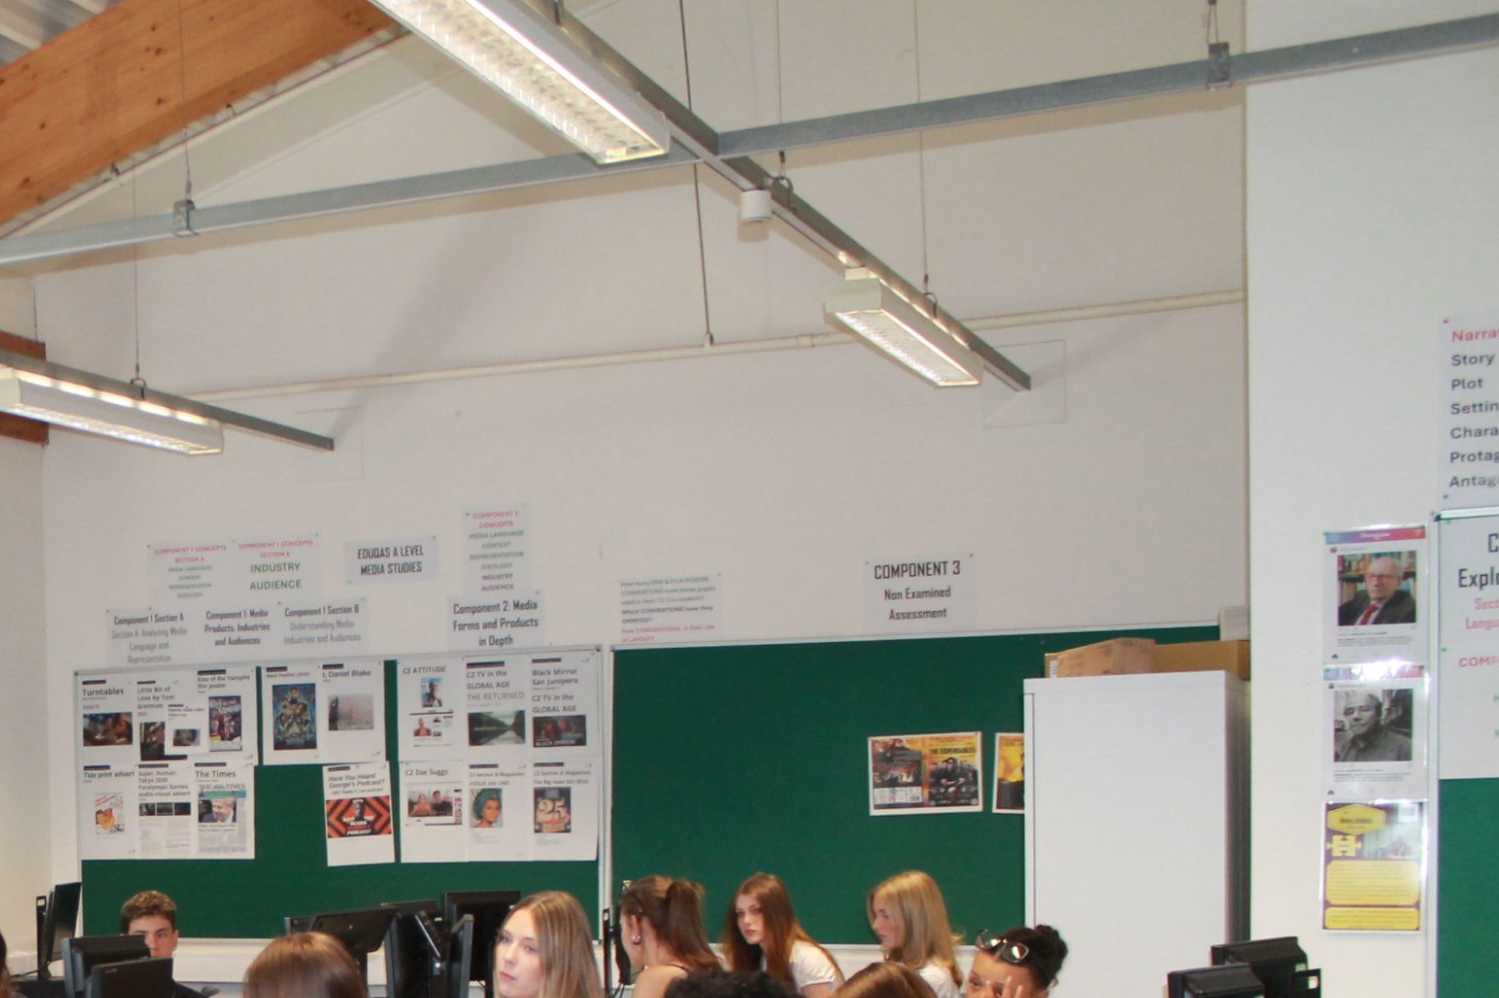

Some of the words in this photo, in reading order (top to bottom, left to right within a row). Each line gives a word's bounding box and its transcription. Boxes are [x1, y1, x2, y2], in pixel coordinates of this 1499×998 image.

[1451, 354, 1495, 369] Story
[1451, 379, 1484, 391] Plot
[1451, 402, 1499, 415] Settin
[473, 511, 514, 519] COMPONENT
[478, 521, 514, 529] CONCEPTS
[468, 532, 488, 540] MEDIA
[490, 530, 524, 538] LANGUAGE
[154, 546, 189, 555] COMPONENT
[239, 541, 275, 550] COMPONENT
[357, 547, 391, 559] EDUQAS
[393, 547, 398, 556] A
[400, 545, 424, 556] LEVEL
[251, 562, 300, 573] INDUSTRY
[360, 564, 385, 575] MEDIA
[387, 561, 422, 574] STUDIES
[874, 561, 948, 580] COMPONENT
[953, 560, 961, 575] 3
[481, 573, 513, 581] INDUSTRY
[250, 580, 301, 590] AUDIENCE
[884, 588, 903, 601] Non
[905, 586, 951, 600] Examined
[285, 607, 321, 618] Component
[327, 605, 352, 615] Section
[354, 604, 359, 613] B
[453, 603, 500, 615] Component
[513, 599, 537, 610] Media
[114, 616, 148, 625] Component
[154, 613, 178, 623] Section
[206, 610, 242, 620] Component
[250, 609, 268, 617] Media
[889, 608, 947, 620] Assessment
[237, 622, 270, 632] Industries
[290, 620, 335, 631] Understanding
[336, 620, 355, 629] Media
[453, 620, 480, 631] Forms
[482, 619, 497, 629] and
[500, 617, 538, 628] Products
[112, 630, 133, 639] Section
[170, 626, 187, 635] Media
[215, 637, 226, 646] and
[228, 637, 260, 645] Audiences
[284, 635, 315, 644] Industries
[317, 634, 328, 643] and
[330, 634, 361, 643] Audiences
[479, 637, 486, 646] in
[489, 634, 513, 647] Depth
[130, 641, 157, 652] Language
[159, 641, 169, 649] and
[127, 655, 172, 664] Representation
[413, 666, 446, 674] ATTITUDE
[466, 671, 475, 679] C2
[495, 669, 507, 677] the
[466, 682, 493, 690] GLOBAL
[82, 687, 124, 697] Turntables
[467, 693, 480, 701] THE
[483, 691, 525, 701] RETURNED
[542, 694, 551, 702] TV
[532, 706, 560, 714] GLOBAL
[98, 771, 113, 779] print
[211, 770, 236, 778] Times
[538, 799, 566, 819] 25
